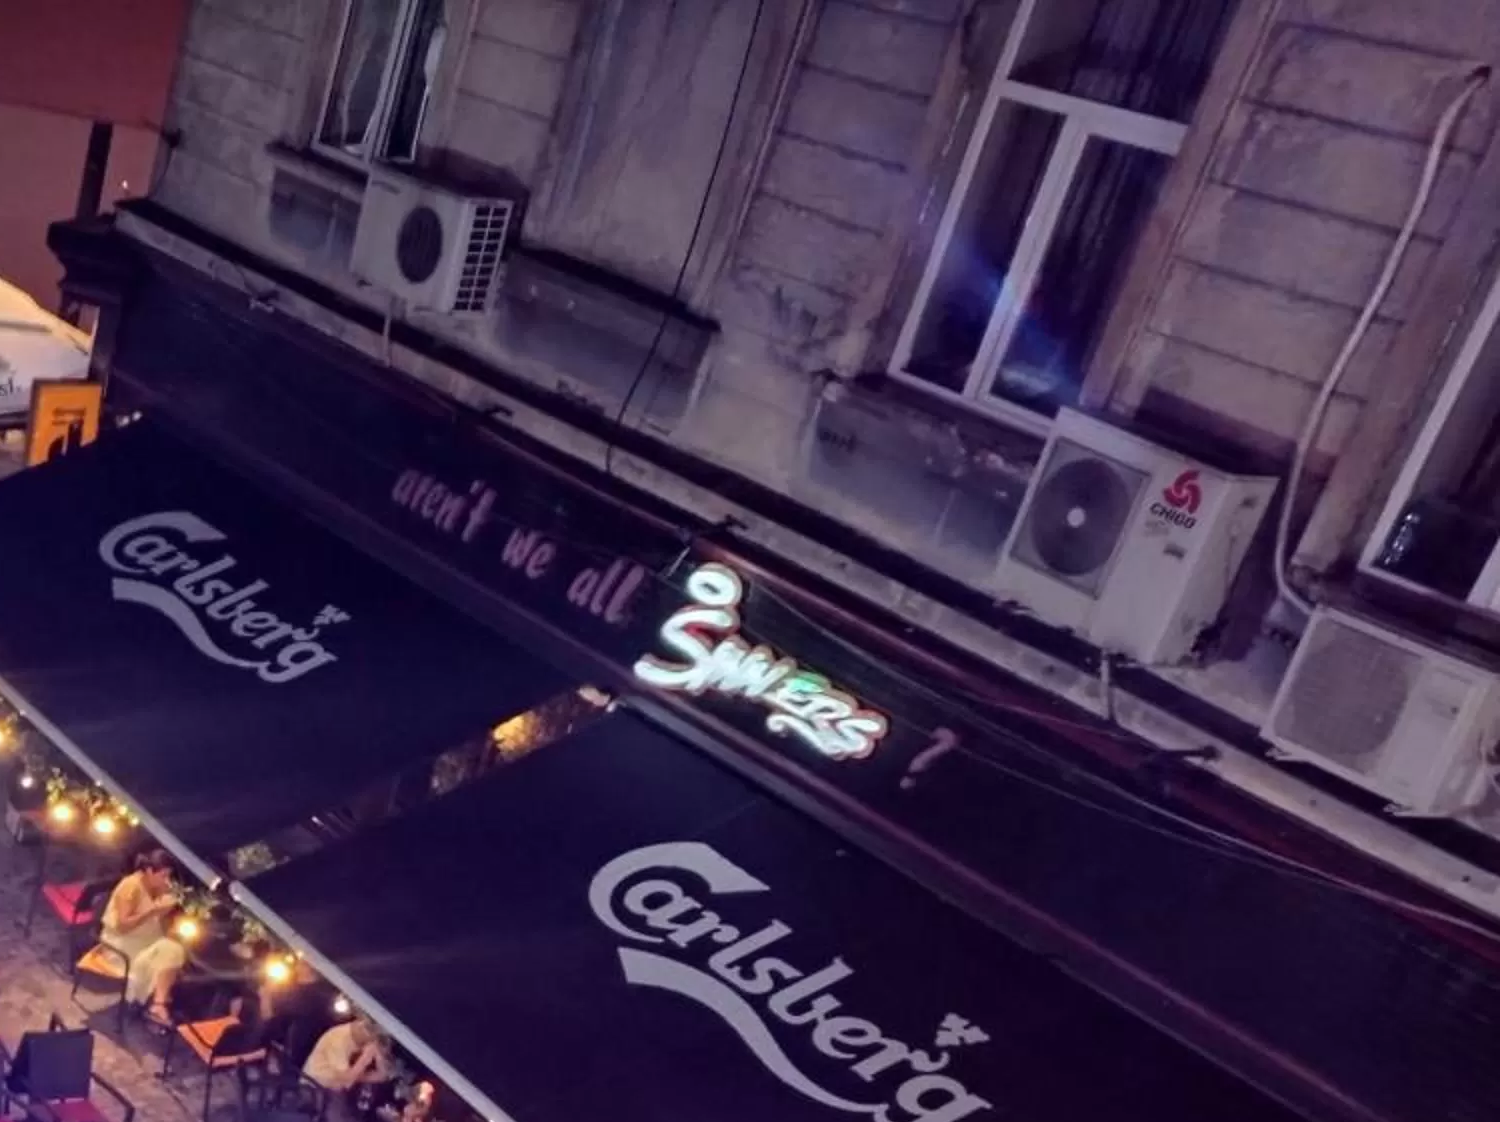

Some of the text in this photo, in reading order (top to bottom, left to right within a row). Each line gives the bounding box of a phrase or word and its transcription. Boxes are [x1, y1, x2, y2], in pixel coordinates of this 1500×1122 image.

[98, 511, 351, 684] Carlsberg
[391, 470, 497, 542] aren't
[502, 528, 556, 579] we
[566, 558, 646, 625] all
